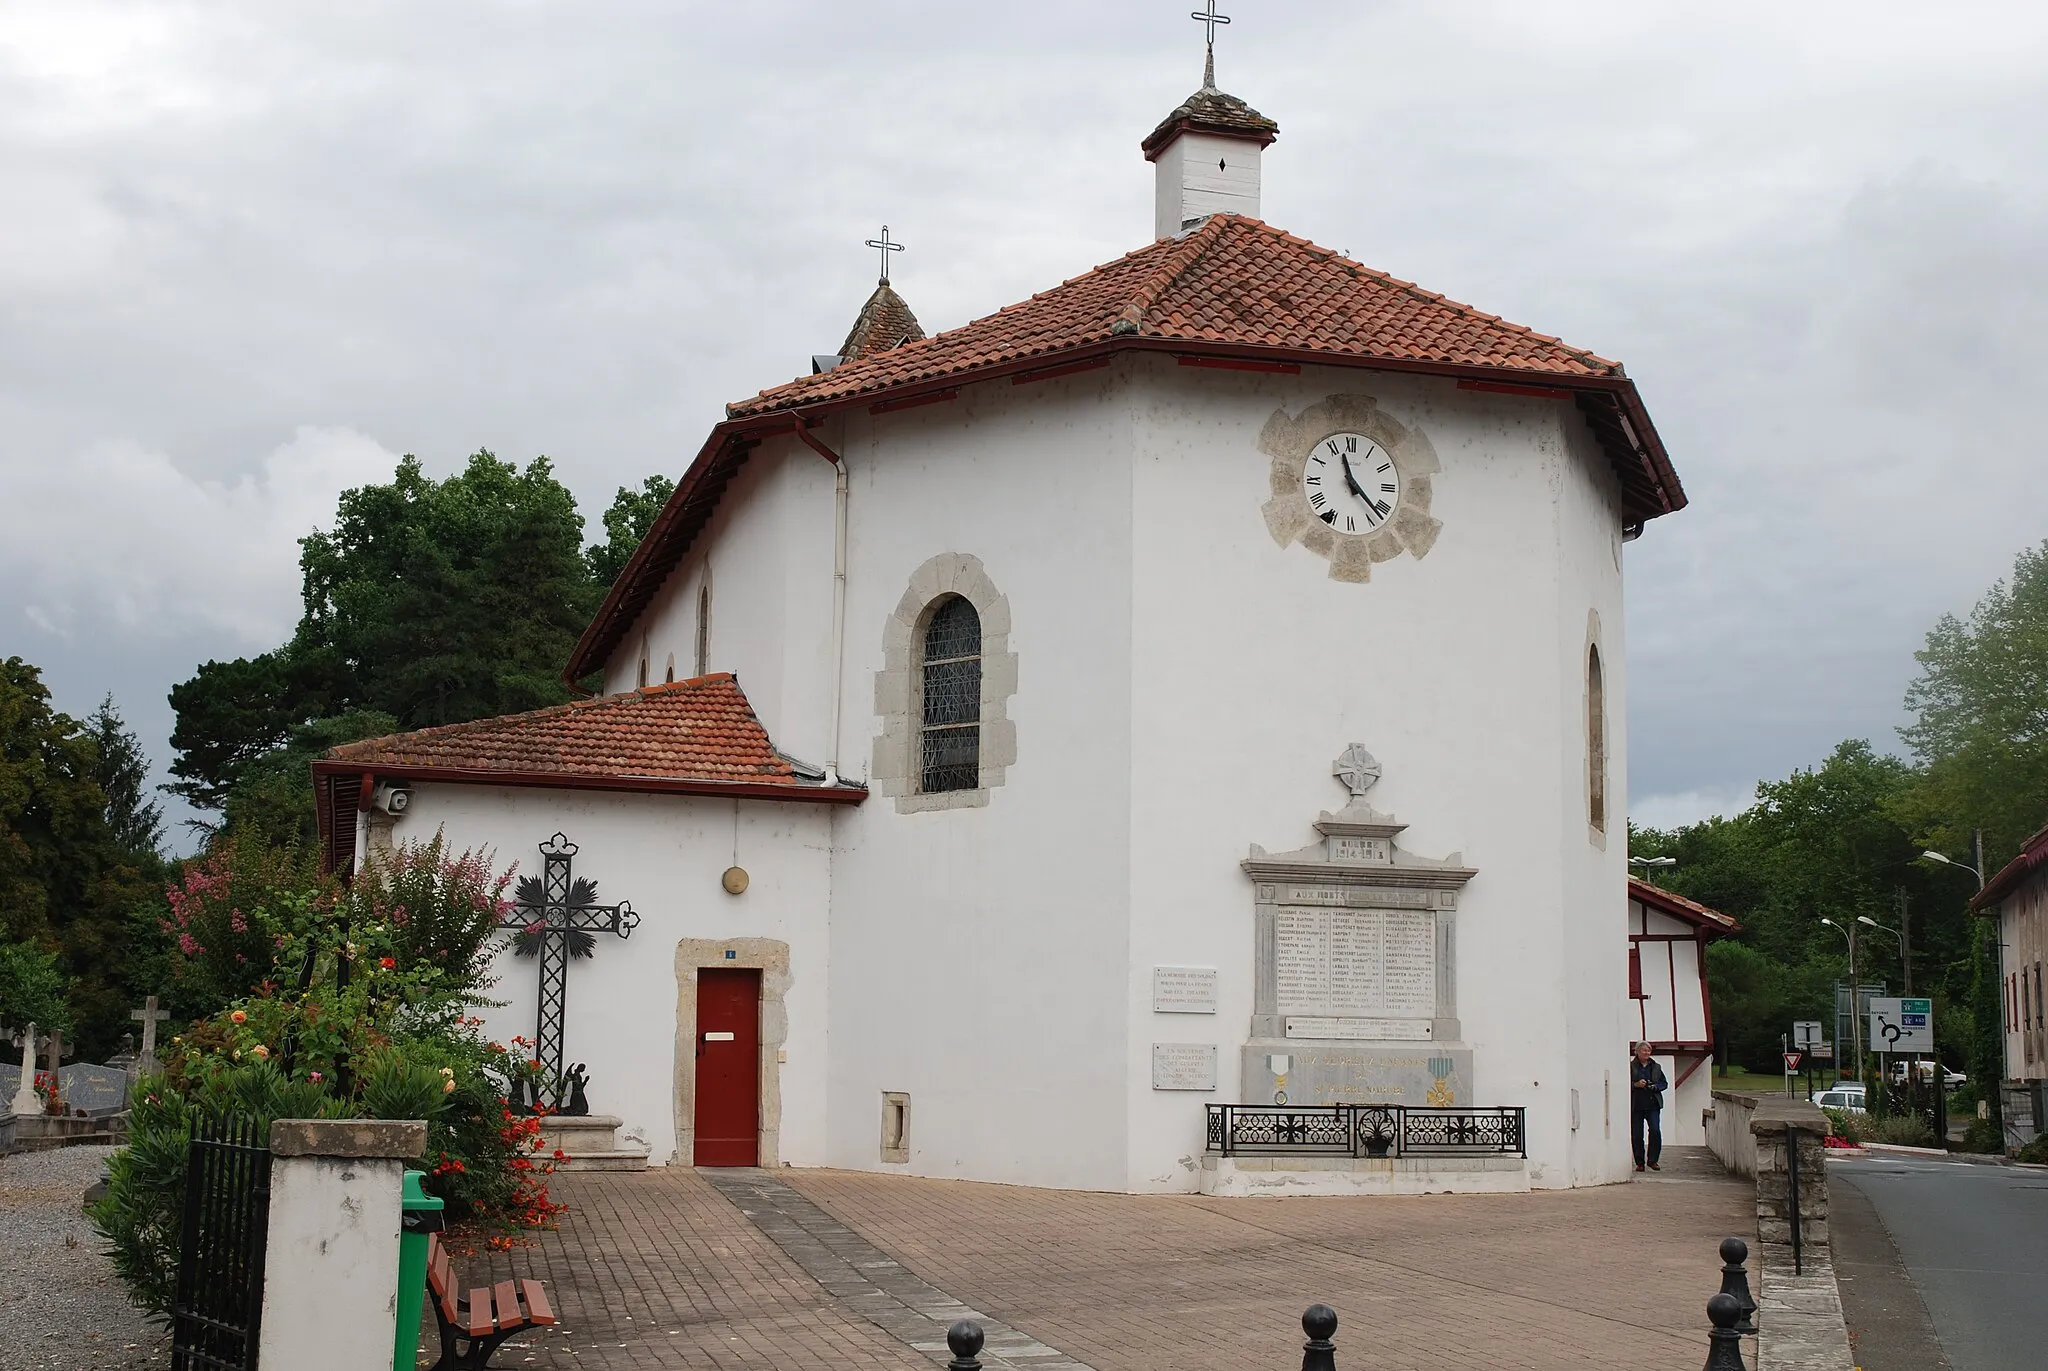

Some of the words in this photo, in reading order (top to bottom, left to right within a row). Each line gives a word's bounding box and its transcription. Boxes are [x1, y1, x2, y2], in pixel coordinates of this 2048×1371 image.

[1326, 439, 1340, 457] XI
[1345, 436, 1357, 453] XII
[1312, 455, 1326, 467] X
[1376, 462, 1391, 473] II
[1380, 483, 1396, 493] III
[1309, 492, 1327, 510] VIII
